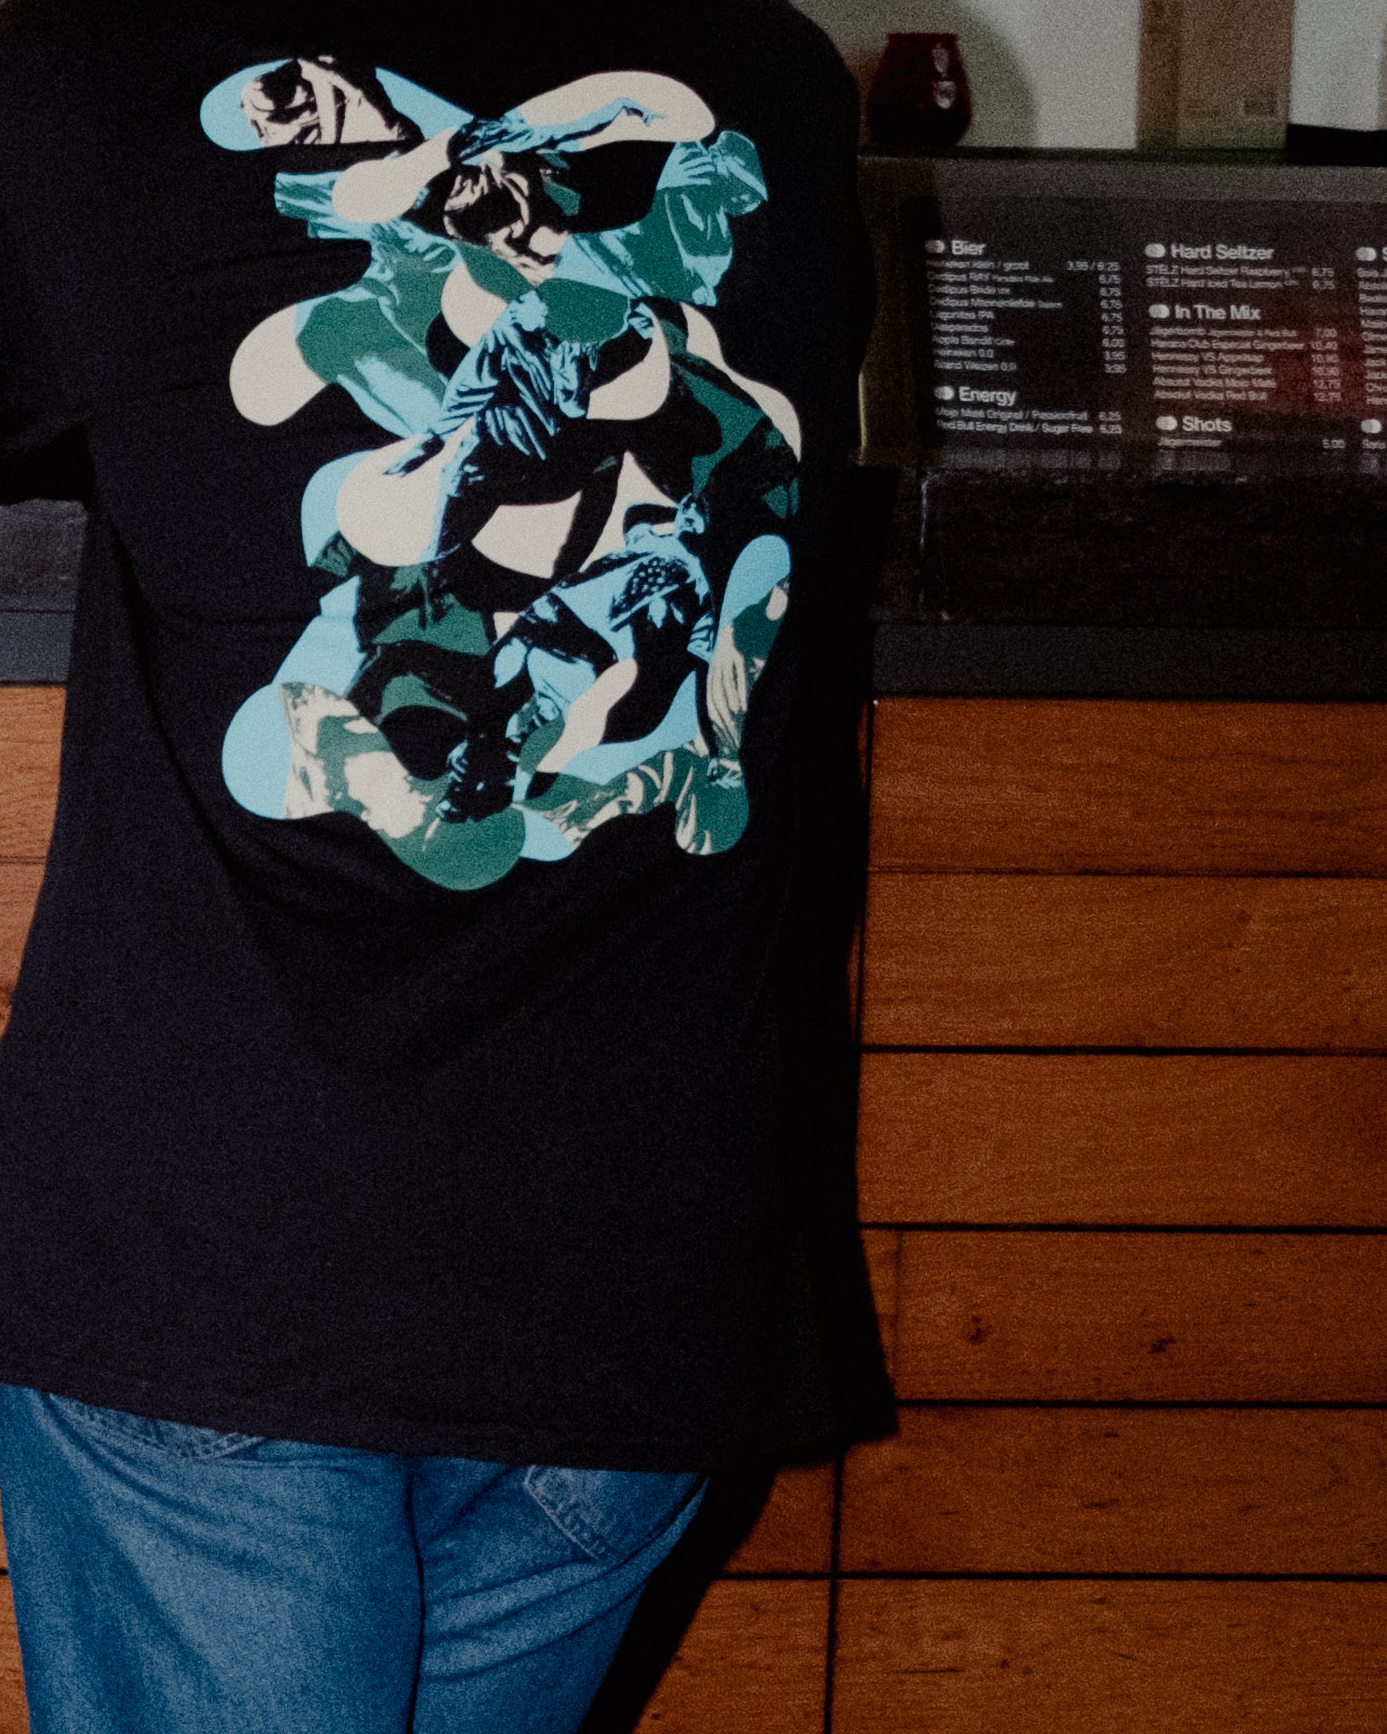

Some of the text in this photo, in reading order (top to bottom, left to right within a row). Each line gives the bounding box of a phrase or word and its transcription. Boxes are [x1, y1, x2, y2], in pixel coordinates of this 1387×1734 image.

[951, 240, 986, 255] Bier
[1170, 243, 1274, 260] Hard Seltzer
[1174, 304, 1261, 320] In The Mix
[958, 387, 1017, 406] Energy
[1182, 415, 1232, 433] Shots
